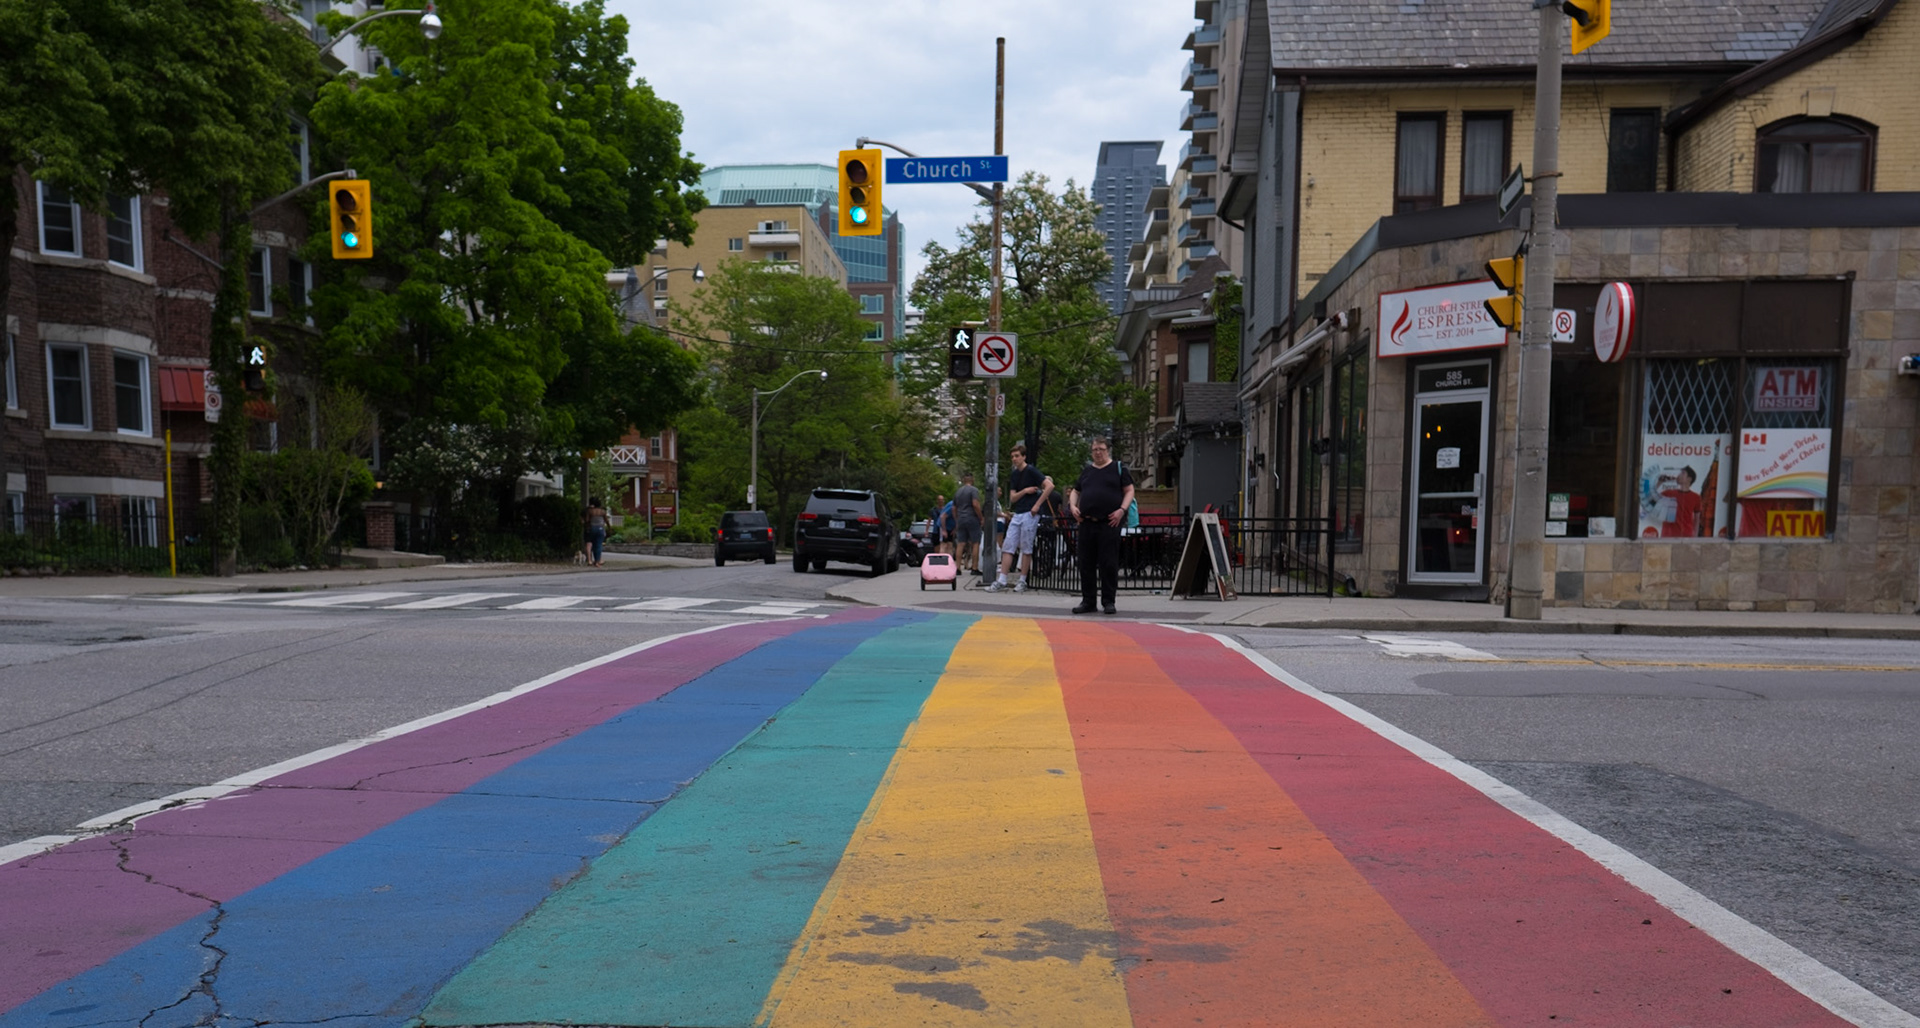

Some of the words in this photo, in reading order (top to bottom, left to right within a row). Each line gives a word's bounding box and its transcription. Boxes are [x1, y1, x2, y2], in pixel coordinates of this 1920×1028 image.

[903, 160, 971, 178] Church
[1417, 303, 1457, 316] CHURCH
[1459, 300, 1484, 310] STRE
[1436, 329, 1454, 339] EST.
[1456, 327, 1474, 337] 2014
[1435, 379, 1462, 388] CHURCH
[1446, 370, 1463, 381] 585
[1759, 369, 1817, 396] ATM
[1759, 397, 1815, 408] INSIDE
[1647, 442, 1712, 456] delicious
[1760, 460, 1780, 477] Food
[1794, 433, 1818, 449] Drink
[1799, 442, 1826, 461] Choice
[1769, 513, 1825, 537] ATM
